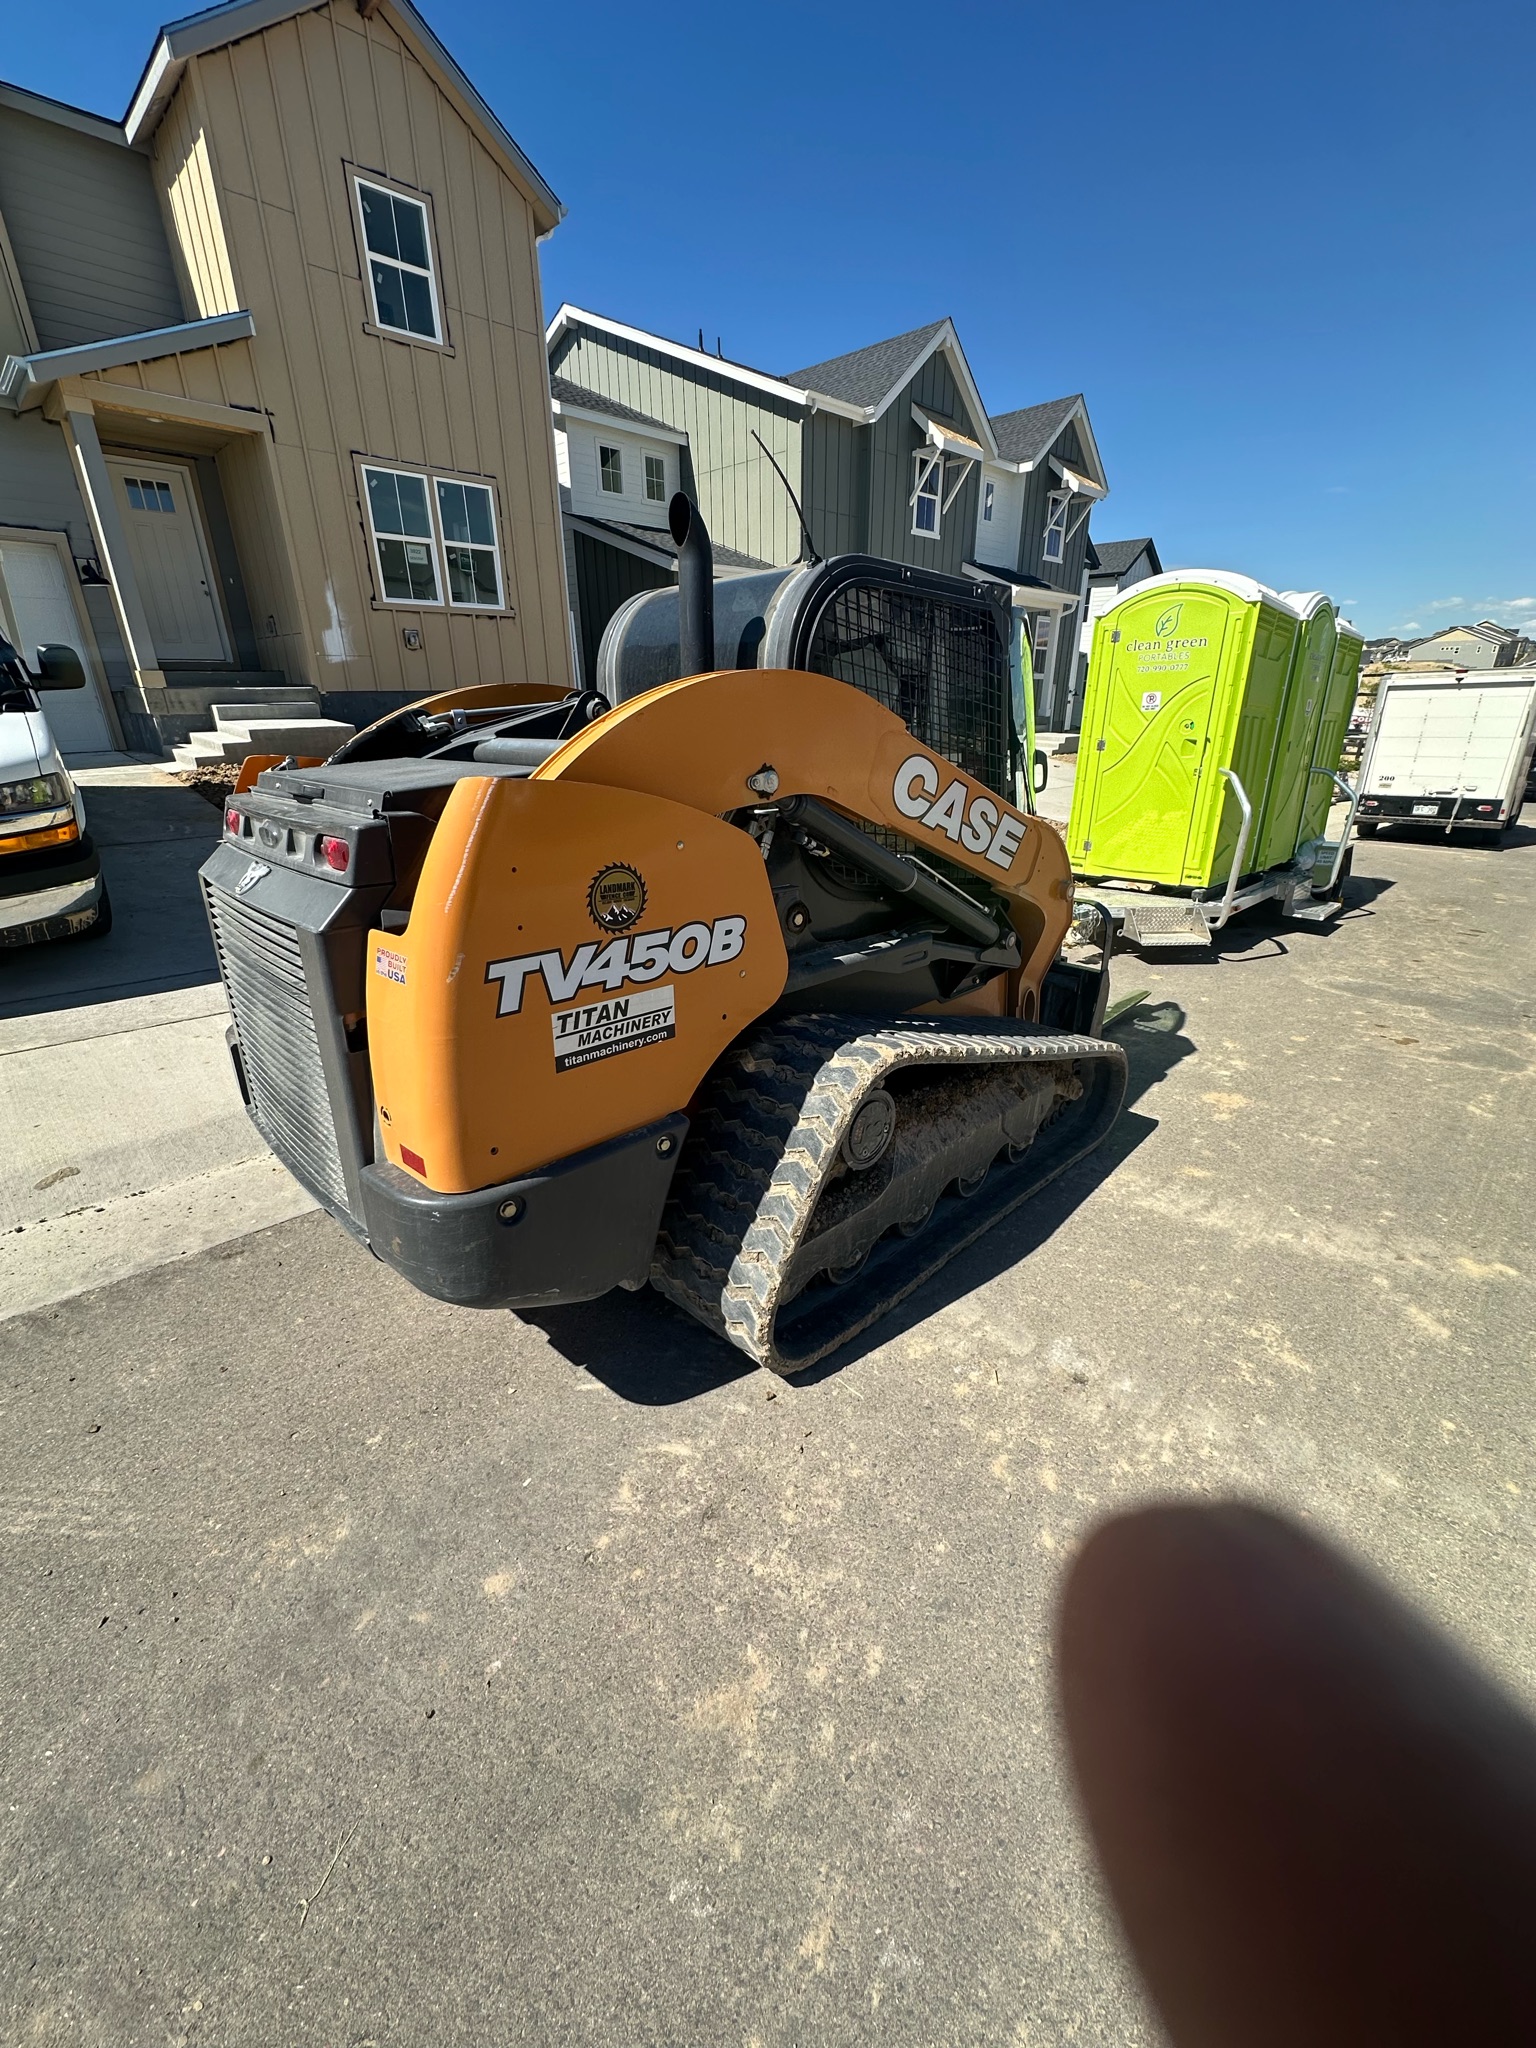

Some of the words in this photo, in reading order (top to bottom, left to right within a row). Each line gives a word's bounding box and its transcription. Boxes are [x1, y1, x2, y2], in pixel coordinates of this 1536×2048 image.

[1126, 638, 1161, 652] clean
[1166, 637, 1208, 653] green
[1138, 651, 1190, 662] PORTABLES
[893, 754, 1028, 872] CASE
[599, 882, 636, 895] LANDMARK
[376, 947, 407, 964] PROUDLY
[387, 960, 407, 973] BUILT
[485, 914, 747, 1018] TV450B
[387, 968, 406, 985] USA
[556, 998, 630, 1034] TITAN
[578, 1010, 672, 1048] MACHINERY
[563, 1029, 669, 1067] titanmachinery.com
